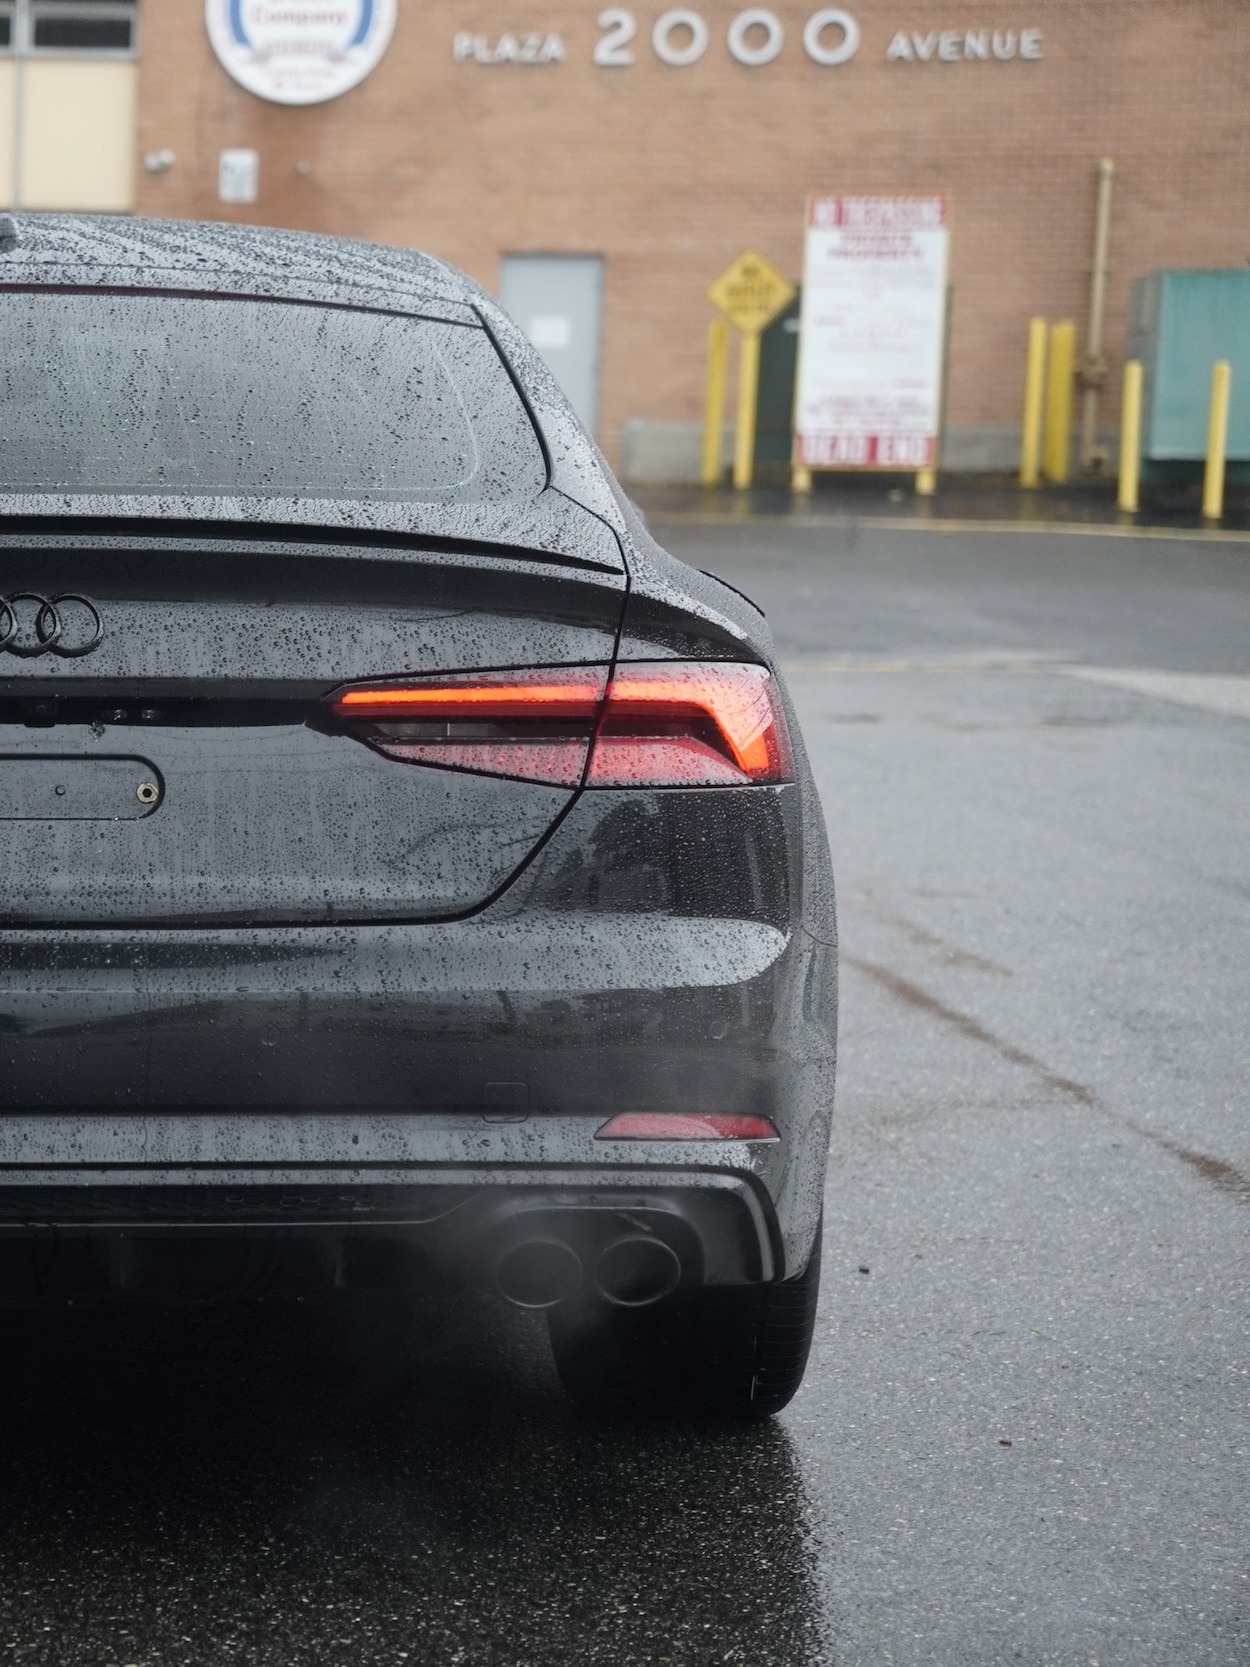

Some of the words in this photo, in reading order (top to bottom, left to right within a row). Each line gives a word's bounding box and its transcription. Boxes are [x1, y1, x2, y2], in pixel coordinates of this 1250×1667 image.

[452, 31, 567, 65] PLAZA
[594, 8, 860, 66] 2000
[885, 28, 1044, 62] AVENUE
